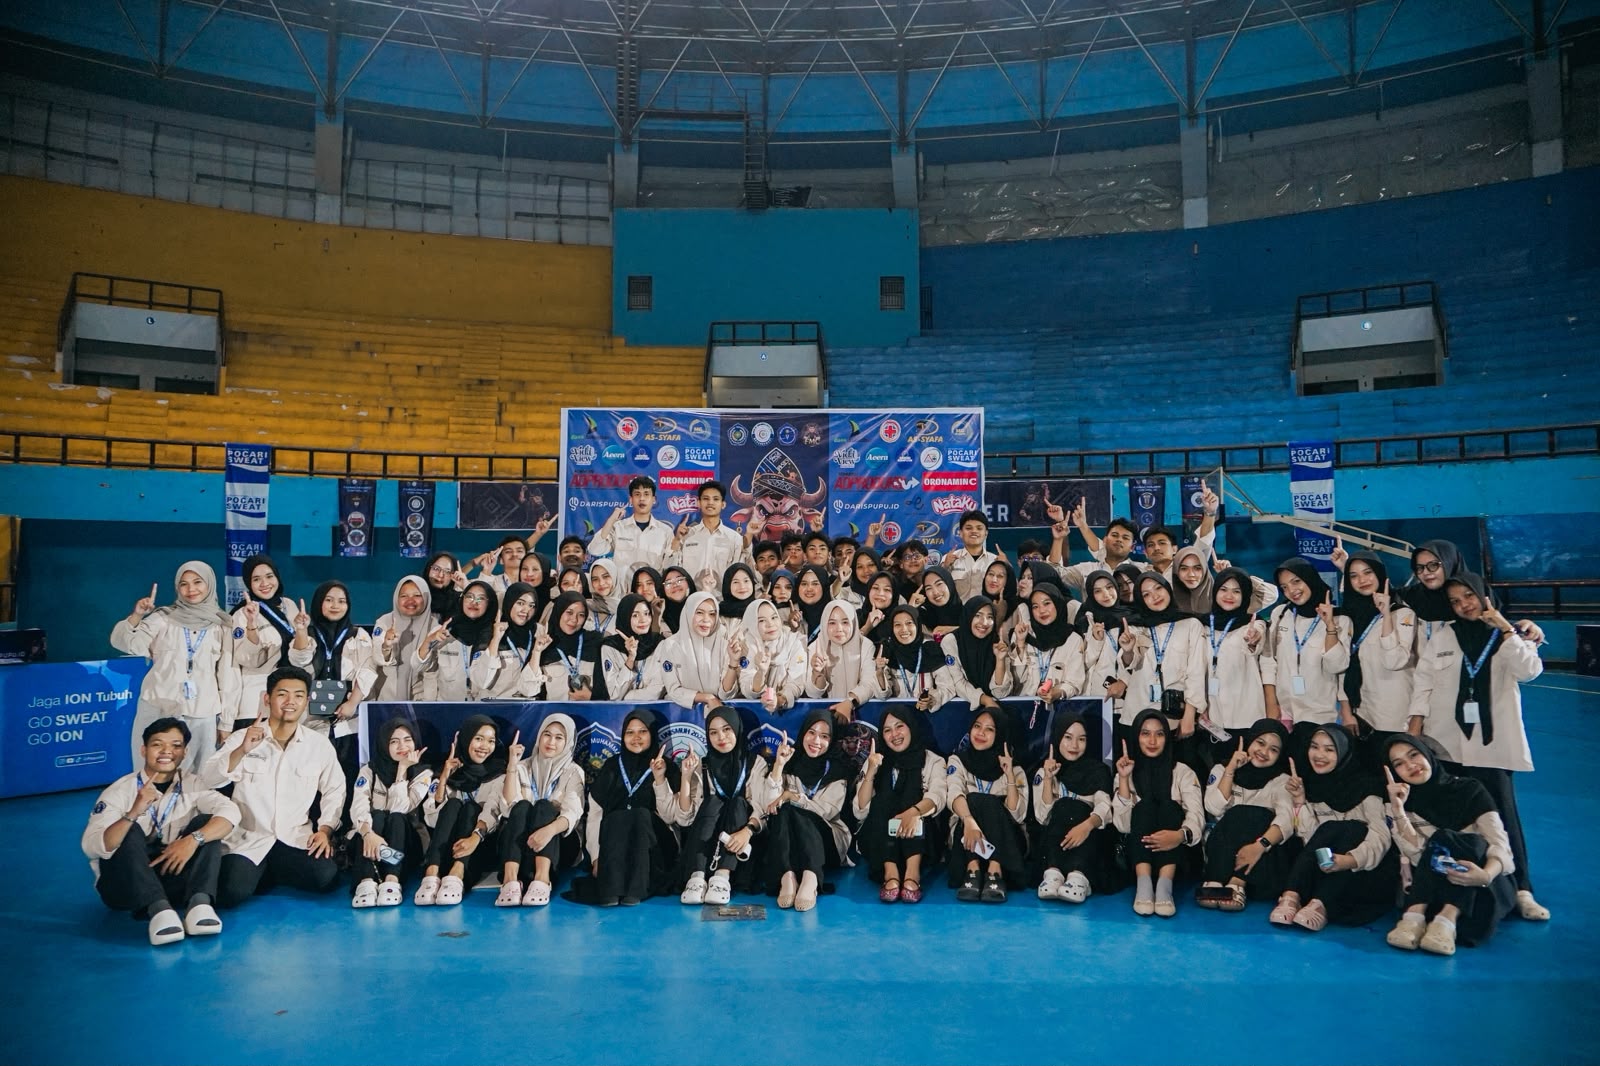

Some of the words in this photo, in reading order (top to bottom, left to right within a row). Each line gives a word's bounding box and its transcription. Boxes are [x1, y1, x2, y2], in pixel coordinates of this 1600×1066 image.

[227, 450, 268, 458] POCARI
[1291, 448, 1330, 456] POCARI
[1291, 454, 1327, 463] SWEAT
[1293, 493, 1333, 502] POCARI
[1294, 500, 1328, 508] SWEAT
[986, 504, 1009, 522] ER
[28, 696, 61, 709] Jaga
[65, 693, 92, 705] ION
[95, 689, 133, 703] Tubuh
[28, 715, 53, 729] GO
[55, 711, 108, 726] SWEAT
[28, 732, 52, 745] GO
[55, 730, 83, 742] ION
